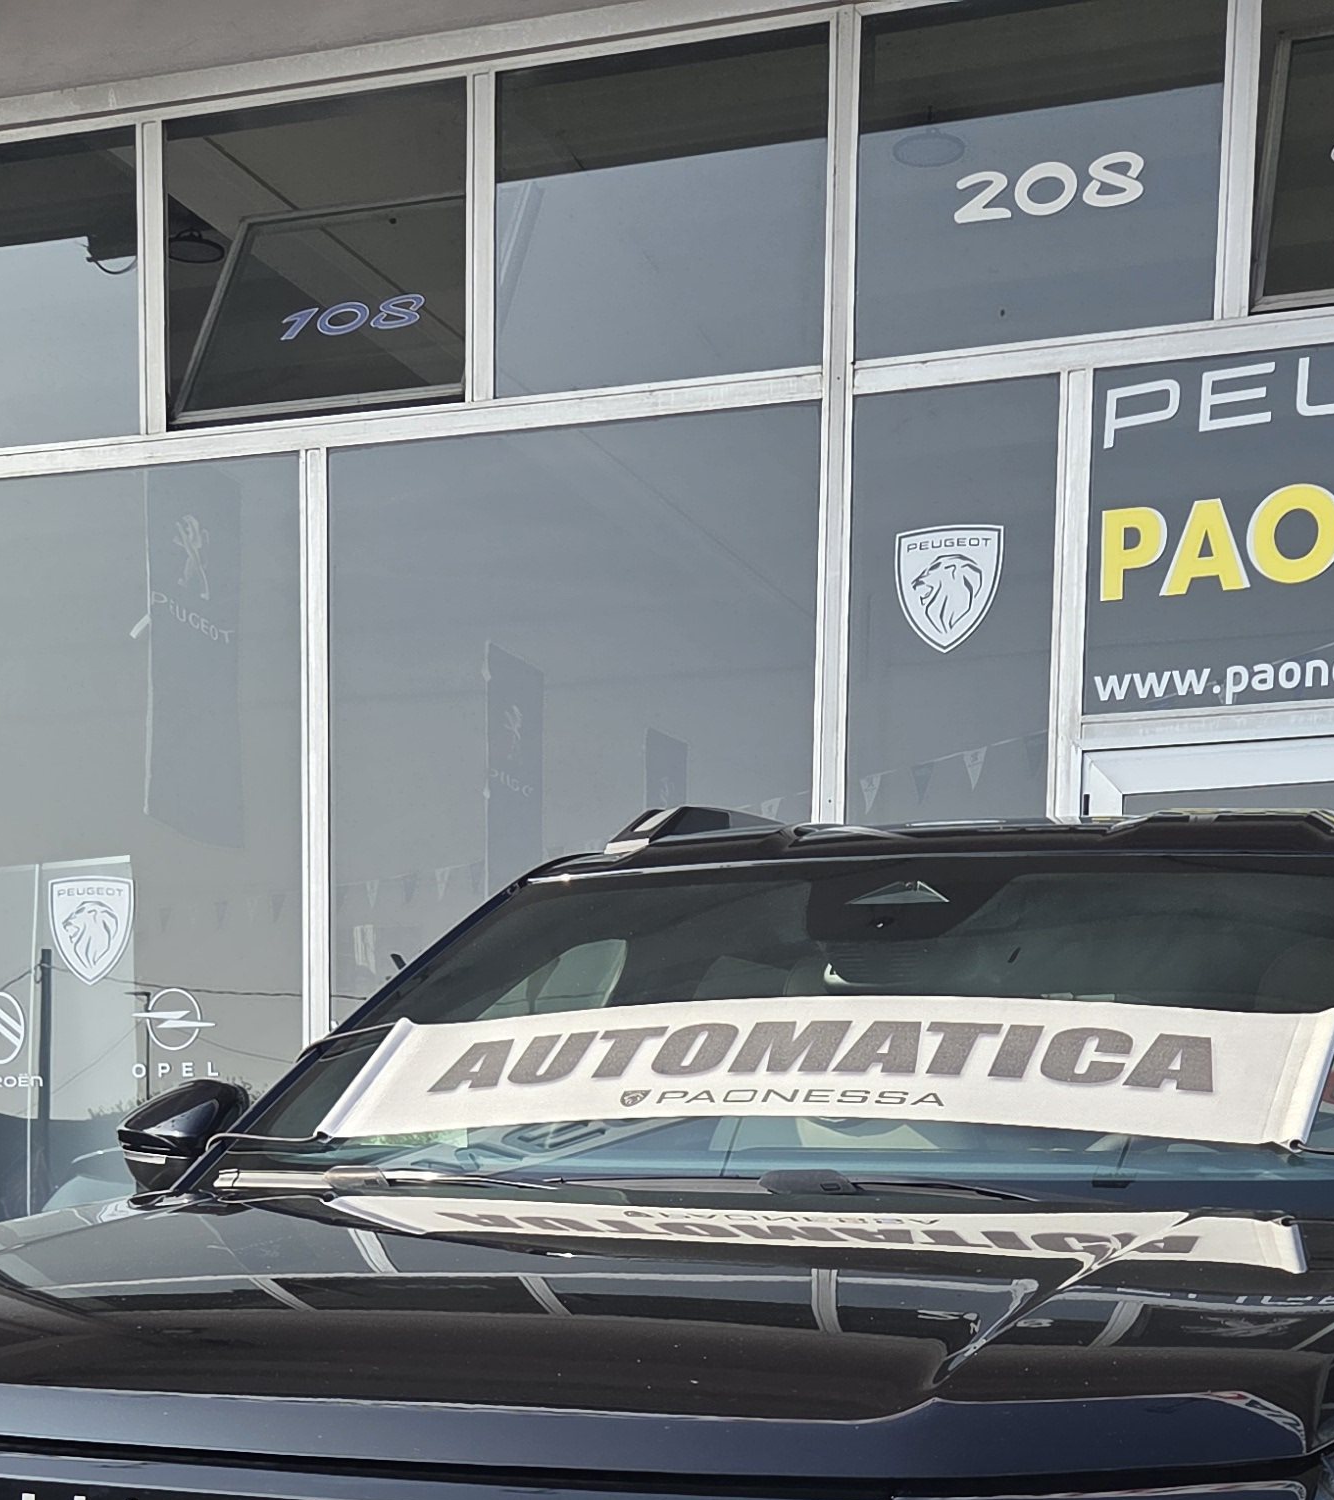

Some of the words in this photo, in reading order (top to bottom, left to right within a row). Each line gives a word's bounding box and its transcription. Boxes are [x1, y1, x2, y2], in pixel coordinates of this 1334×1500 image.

[953, 150, 1146, 225] 208
[279, 292, 426, 343] 108
[905, 536, 993, 552] PEUGEOT
[57, 887, 124, 898] PEUGEOT
[428, 1020, 1216, 1096] AUTOMATICA
[132, 1061, 219, 1078] OPEL
[656, 1088, 944, 1107] PAONESSA
